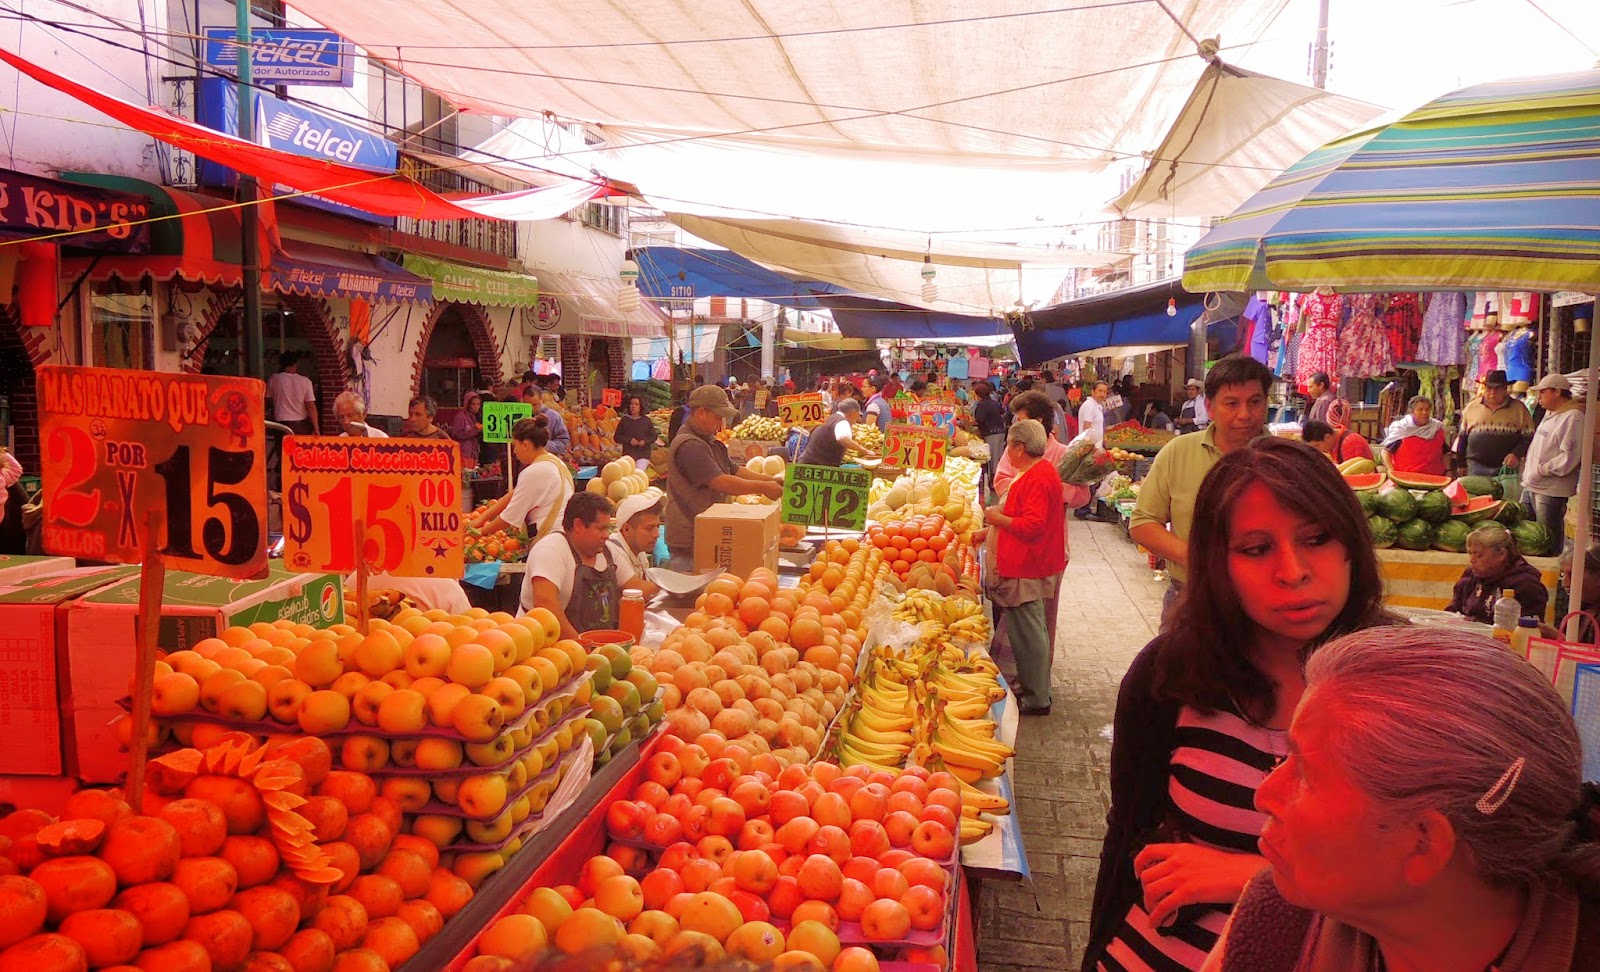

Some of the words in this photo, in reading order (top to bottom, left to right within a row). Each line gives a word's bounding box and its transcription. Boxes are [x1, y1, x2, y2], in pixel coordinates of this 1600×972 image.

[252, 37, 330, 63] telcel
[275, 67, 330, 77] Autorizado
[293, 120, 363, 162] telcel
[299, 270, 325, 285] telcel
[486, 281, 510, 295] CLUB
[396, 285, 417, 297] telcel
[671, 286, 692, 296] SITIO
[44, 372, 84, 415] MAS
[85, 375, 165, 421] BARATO
[167, 380, 209, 432] QUE
[783, 407, 793, 423] 2
[801, 404, 821, 421] 20
[487, 414, 497, 432] 3
[105, 441, 147, 468] POR
[293, 446, 349, 469] Calidad
[351, 447, 449, 472] Seleccionada
[883, 436, 901, 466] 2
[916, 439, 944, 470] 15
[48, 426, 99, 526] 2
[805, 468, 858, 484] REMATE
[155, 445, 259, 565] 15
[418, 478, 454, 507] 00
[789, 482, 808, 508] 3
[817, 487, 859, 528] 12
[117, 471, 137, 548] X
[420, 512, 459, 531] KILO
[47, 529, 104, 556] KILOS
[176, 619, 186, 649] APPLES
[10, 669, 19, 695] GALA
